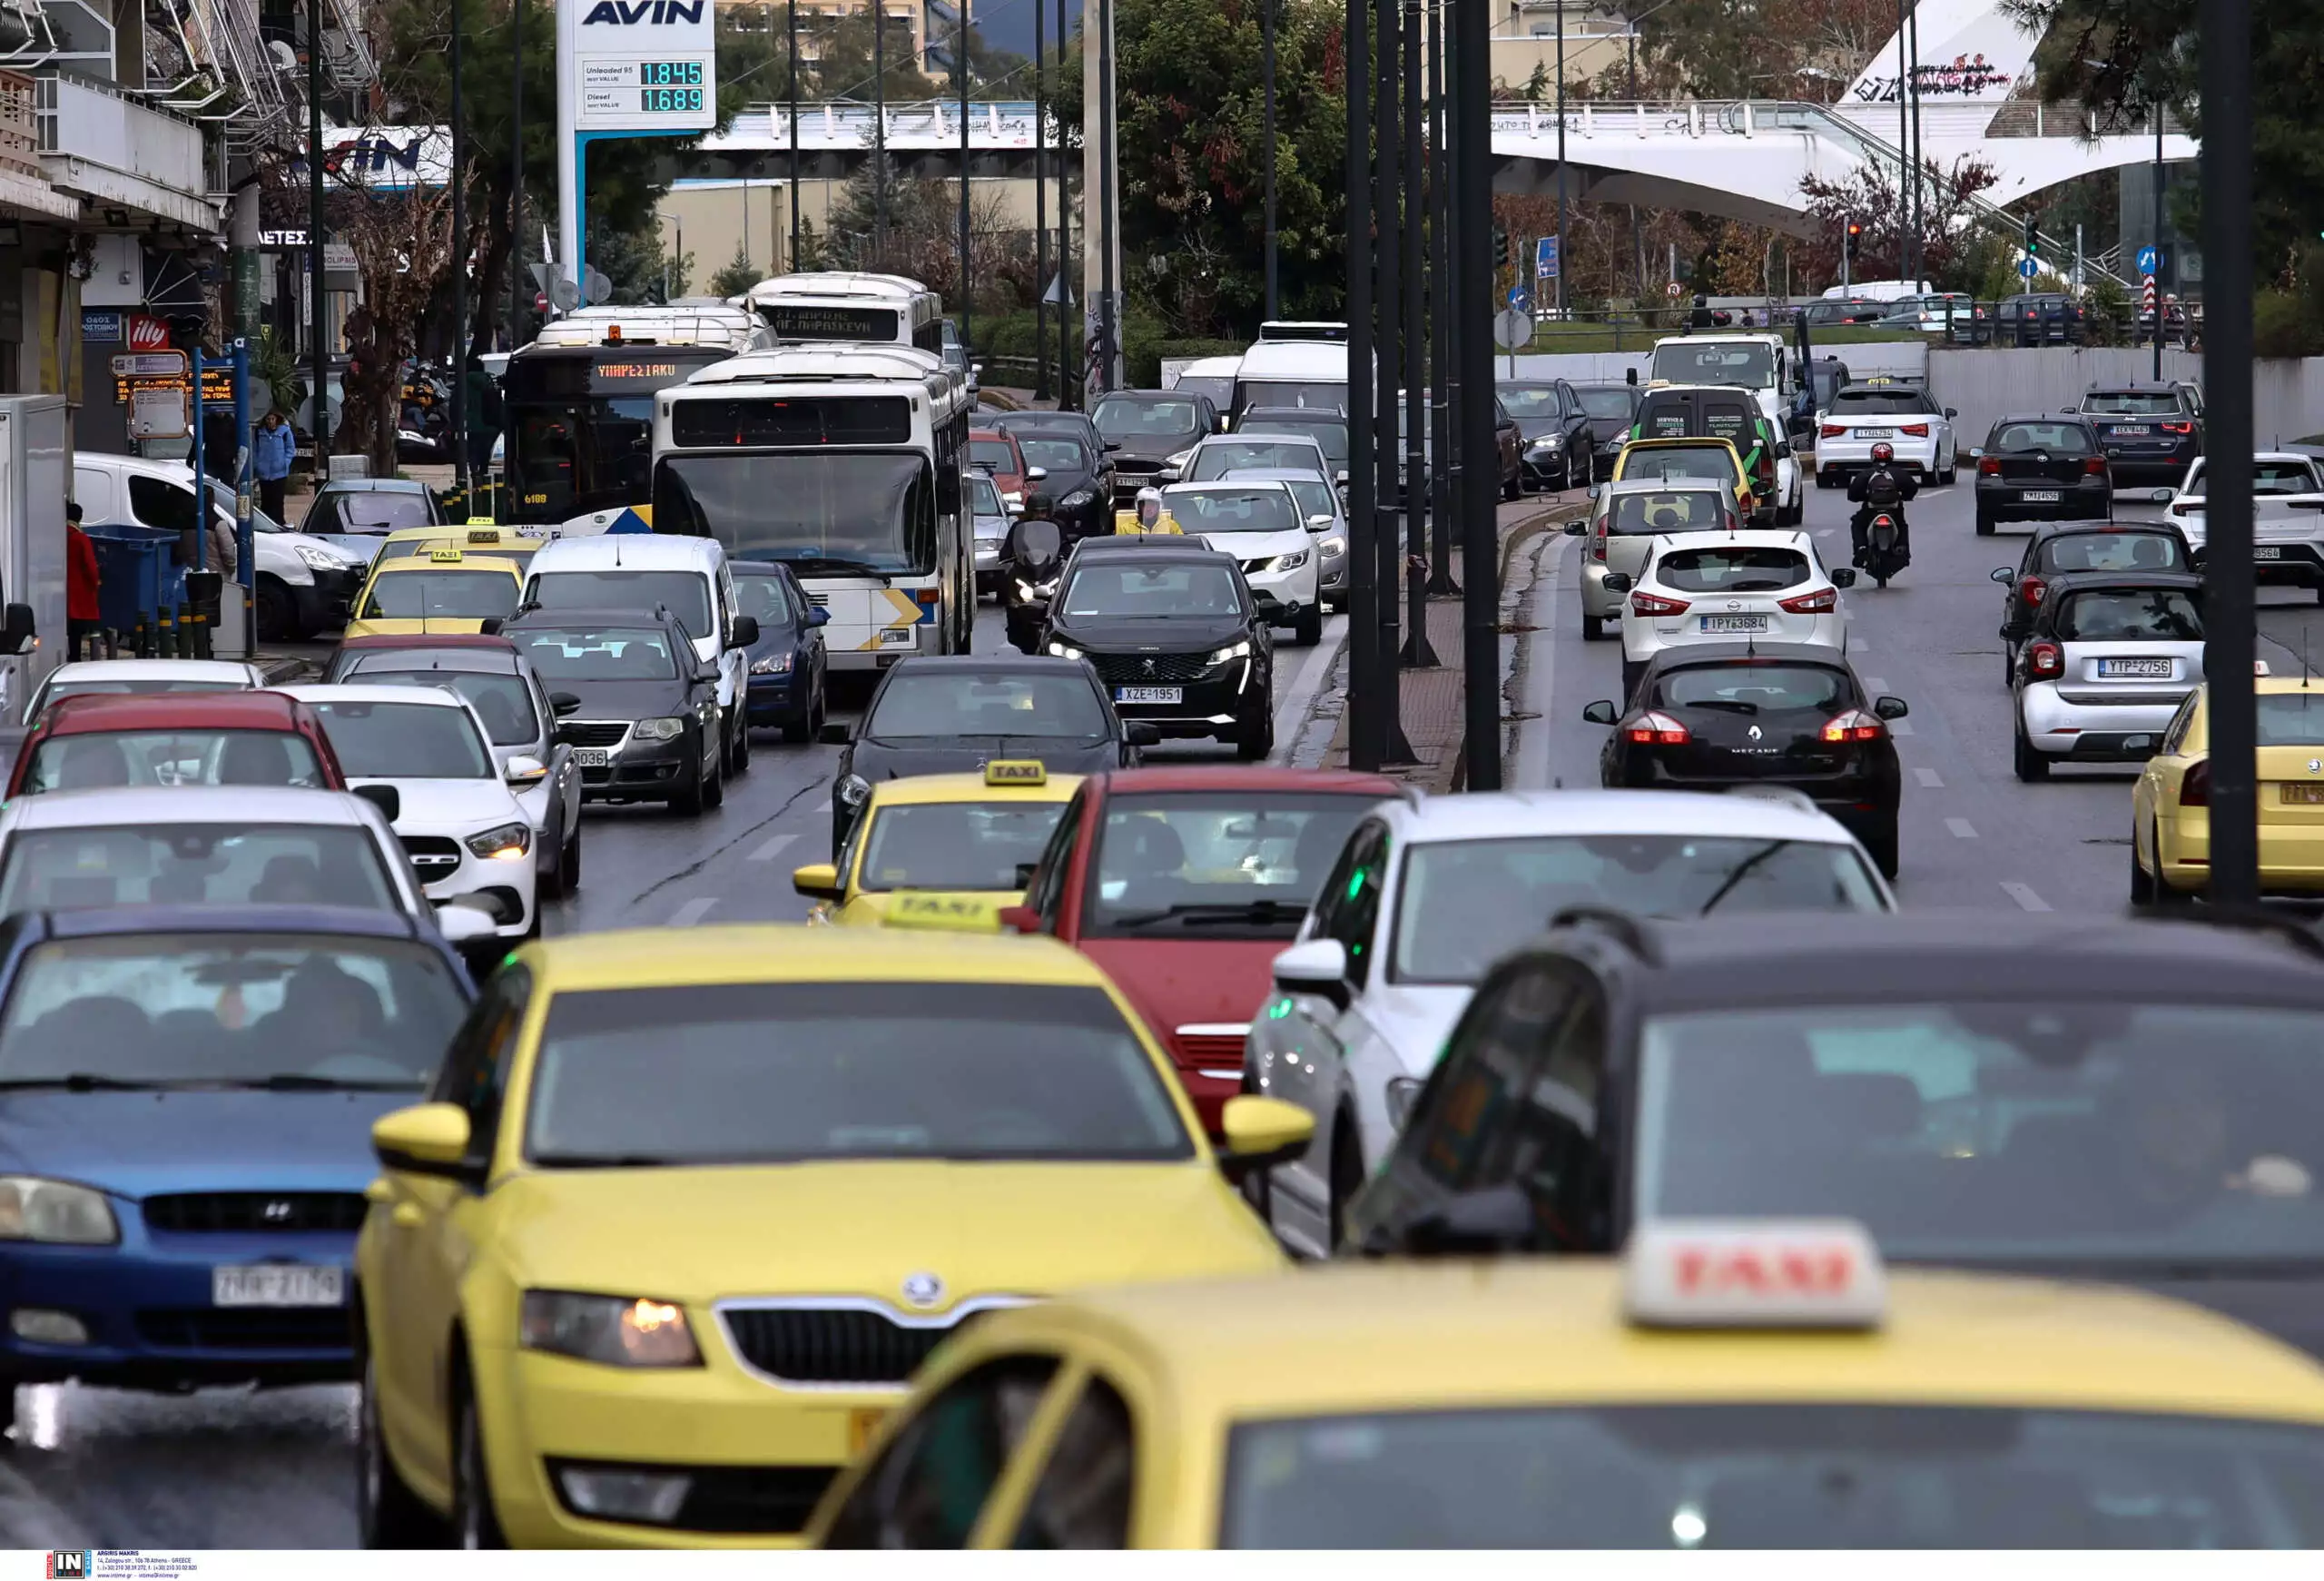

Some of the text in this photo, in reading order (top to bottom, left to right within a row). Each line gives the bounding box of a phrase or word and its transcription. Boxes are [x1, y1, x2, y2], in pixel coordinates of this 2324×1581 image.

[582, 0, 704, 25] AVIN
[645, 64, 701, 84] 1.845
[645, 90, 701, 110] 1.689
[133, 320, 165, 349] illy
[993, 766, 1040, 778] TAXI
[901, 897, 983, 917] TAXI
[1672, 1246, 1852, 1297] TAXI
